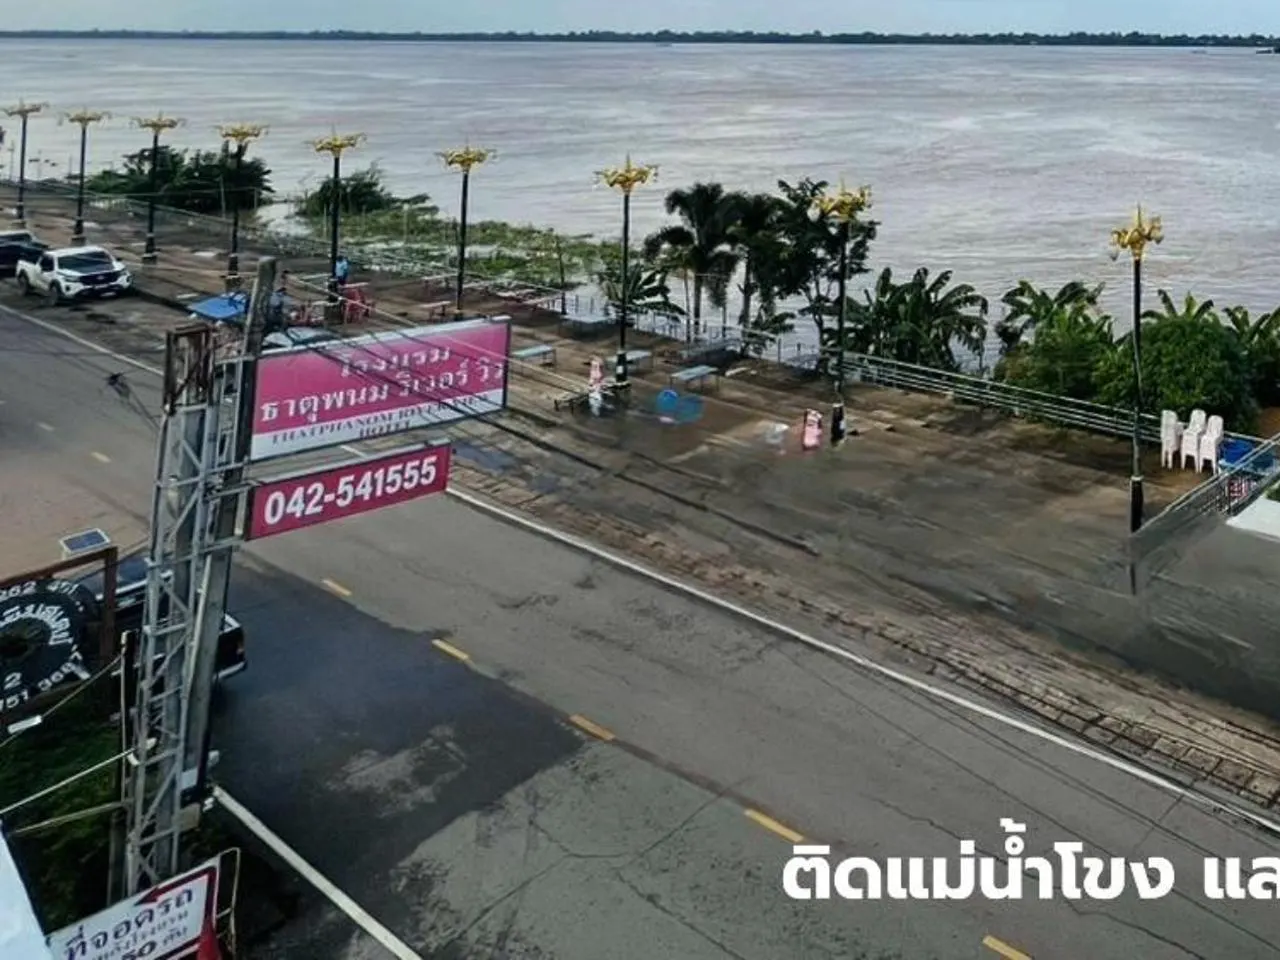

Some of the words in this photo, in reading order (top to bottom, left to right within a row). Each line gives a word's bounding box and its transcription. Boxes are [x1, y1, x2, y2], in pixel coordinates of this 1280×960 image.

[260, 383, 390, 423] ธาตุพนม
[263, 456, 438, 526] 042-541555
[63, 888, 194, 960] ที่จอดรถ
